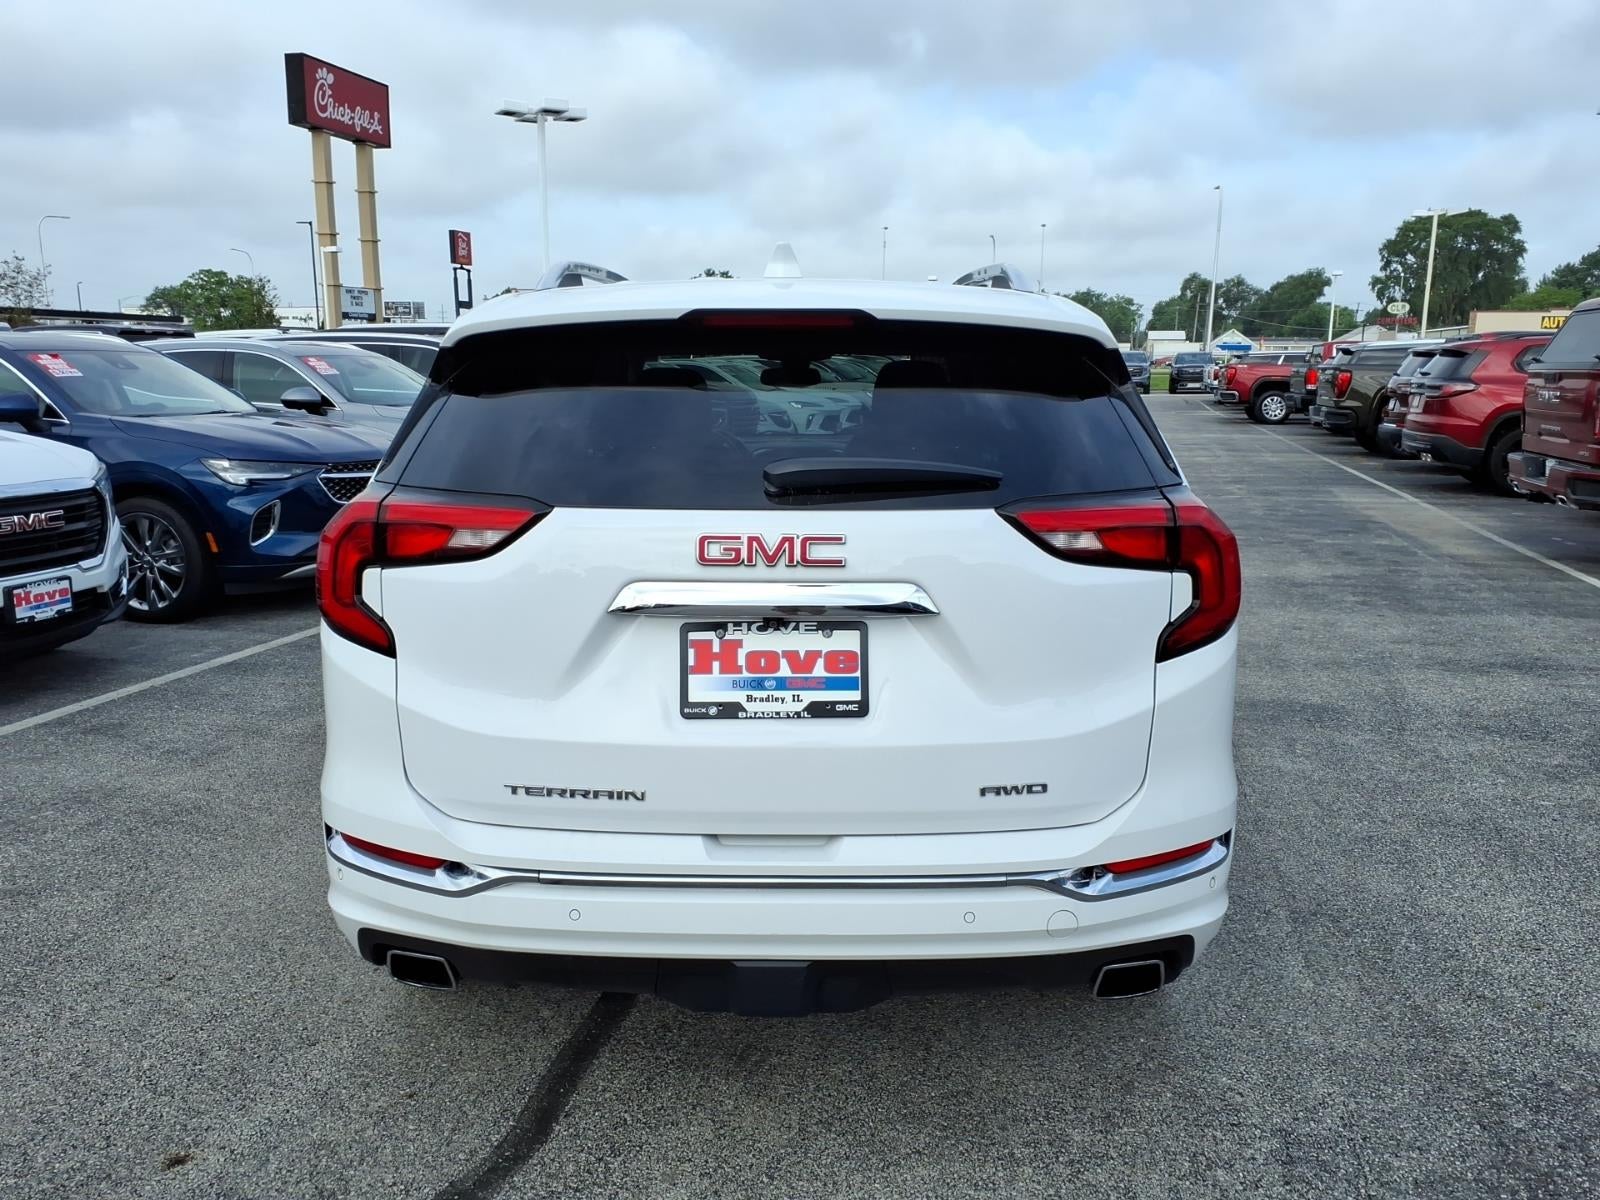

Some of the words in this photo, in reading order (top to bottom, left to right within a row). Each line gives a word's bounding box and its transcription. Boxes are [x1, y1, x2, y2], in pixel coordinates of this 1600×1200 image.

[314, 67, 383, 134] Chick-fil-A
[696, 533, 846, 567] GMC
[13, 587, 70, 608] Hove
[726, 621, 819, 636] HOVE
[688, 638, 860, 675] Hove
[732, 679, 765, 689] BUICK
[786, 677, 826, 689] GMC
[746, 694, 788, 705] Bradley,
[792, 694, 803, 704] IL
[801, 711, 812, 719] IL
[835, 703, 859, 712] GMC
[503, 784, 646, 802] TERRAIN
[979, 783, 1048, 797] AWD
